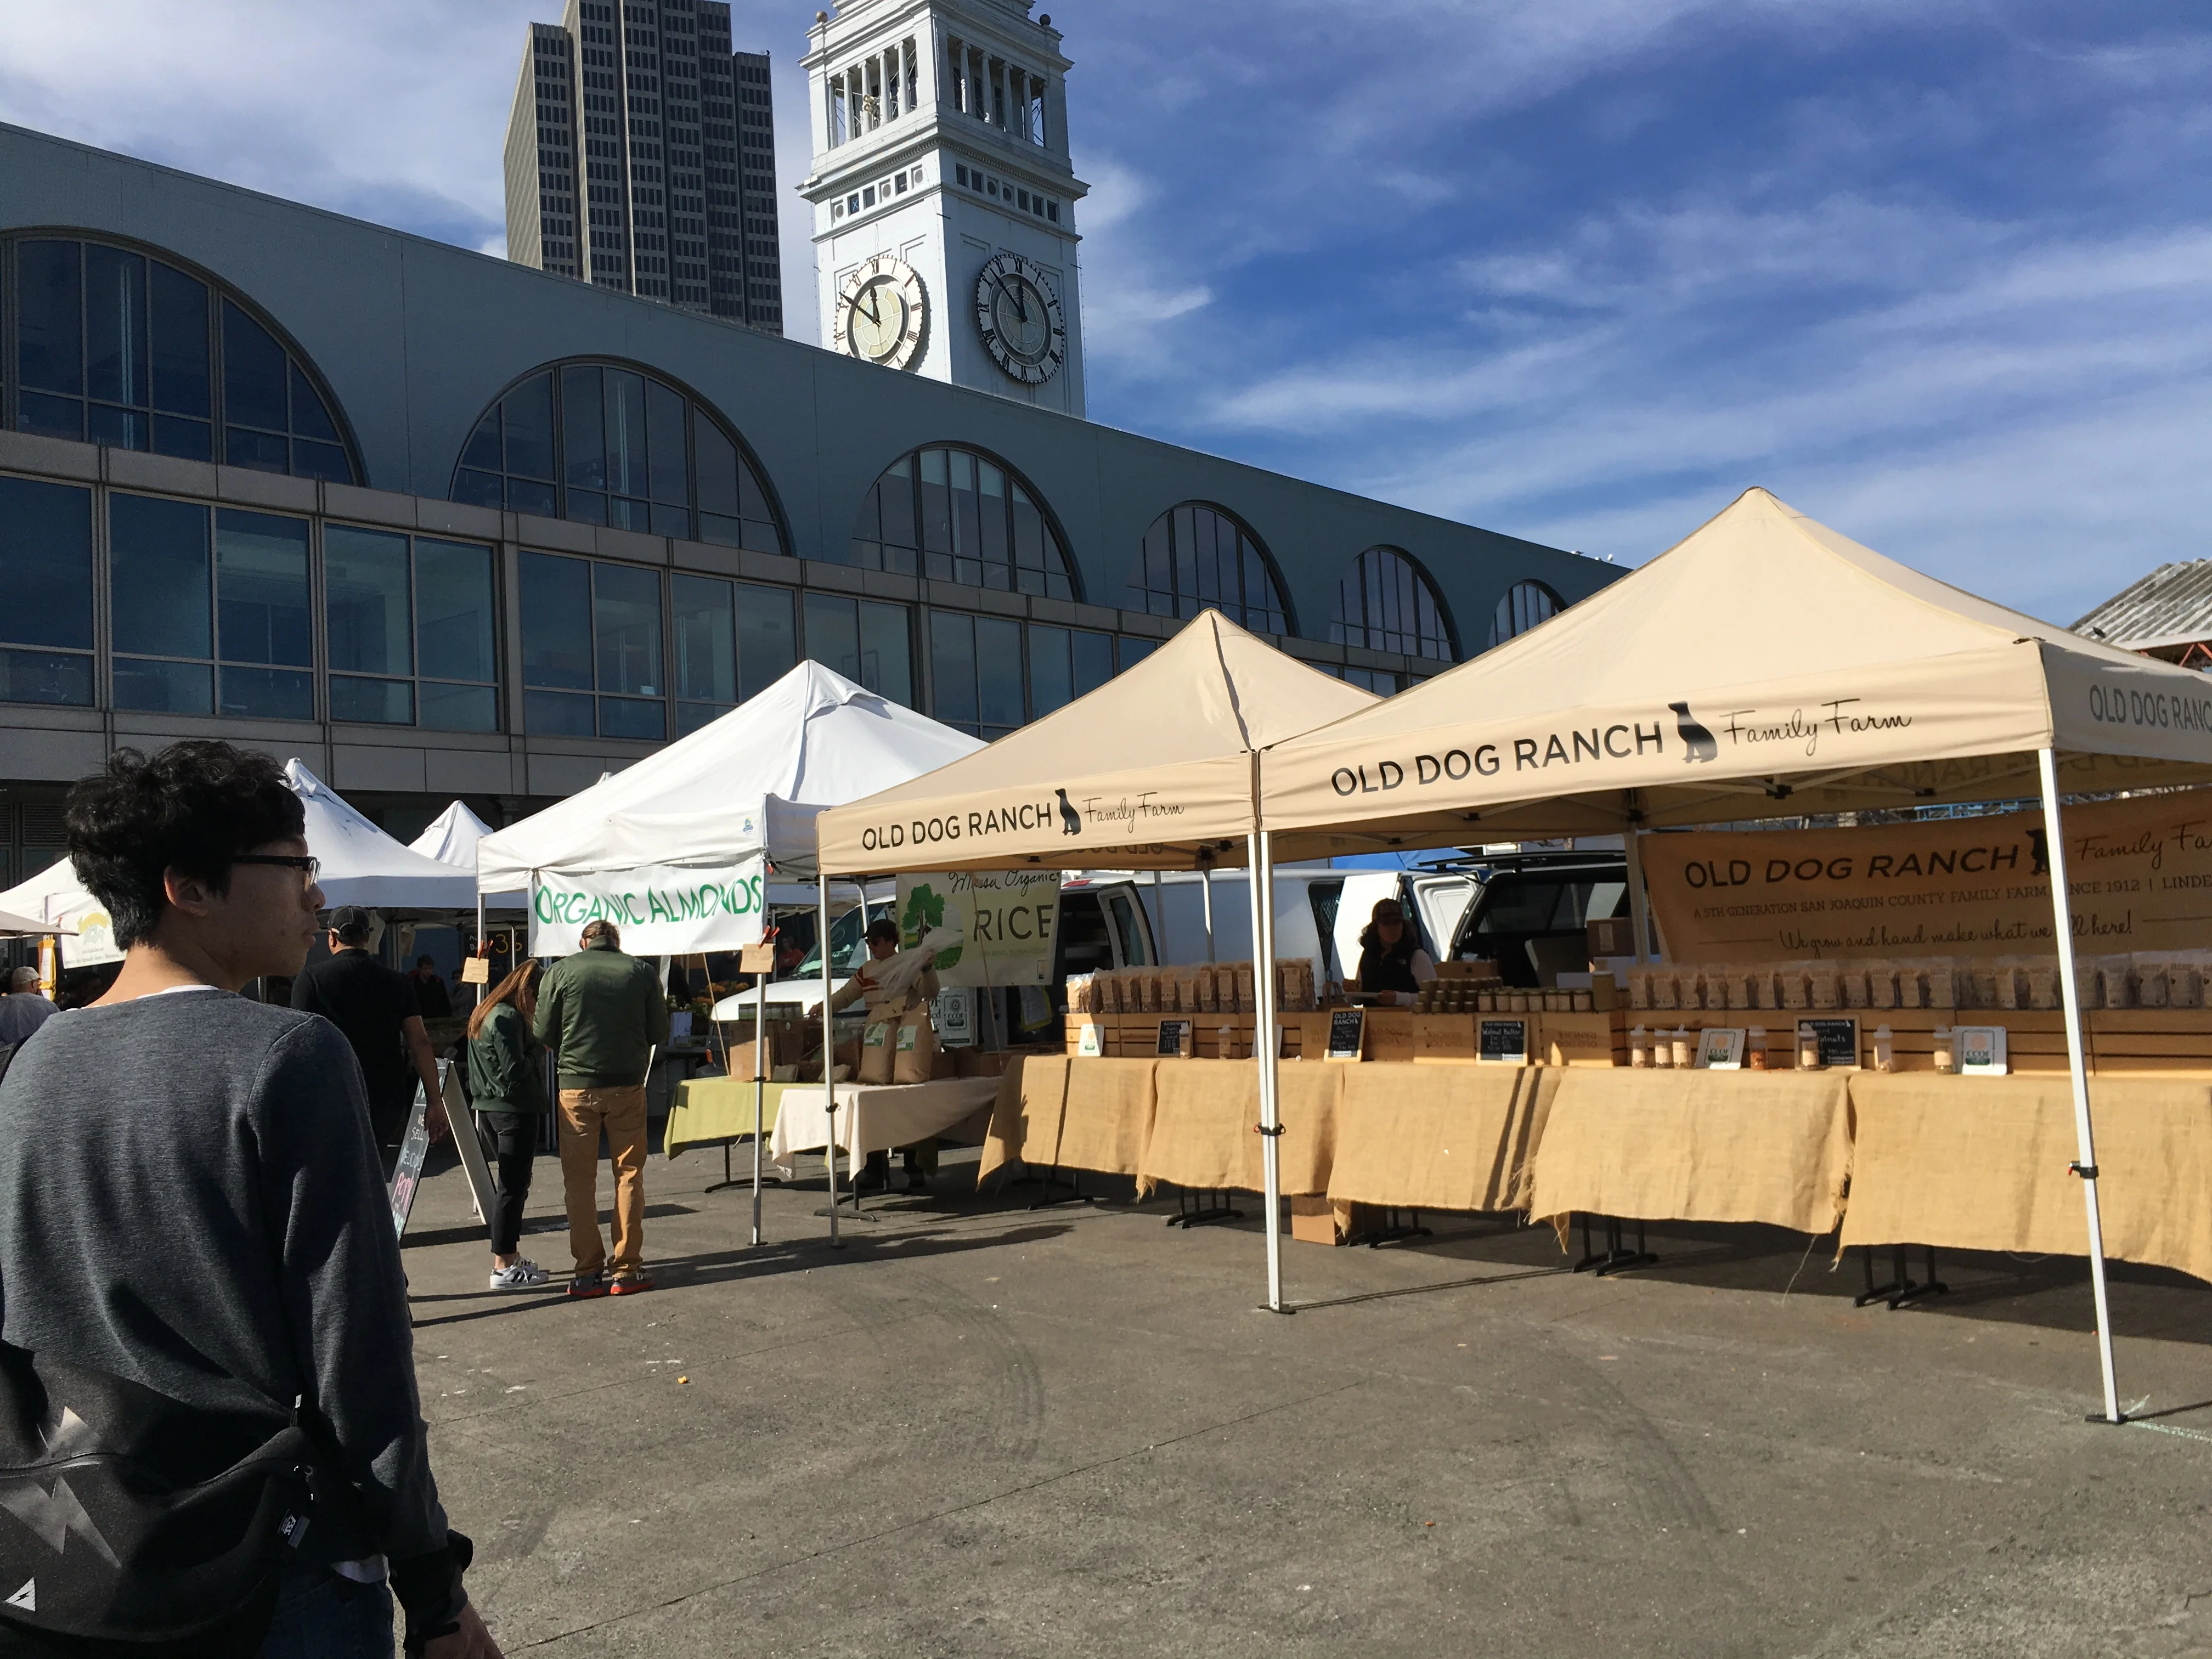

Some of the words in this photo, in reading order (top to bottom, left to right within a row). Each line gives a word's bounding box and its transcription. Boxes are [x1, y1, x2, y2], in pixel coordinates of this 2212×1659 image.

[1718, 708, 1818, 757] Family
[1821, 698, 1912, 735] Farm
[2089, 685, 2127, 724] OLD
[2130, 690, 2169, 728] DOG
[1331, 760, 1404, 797] OLD
[1415, 744, 1499, 785] DOG
[1514, 720, 1663, 771] RANCH
[862, 824, 904, 851] OLD
[912, 815, 961, 844] DOG
[968, 802, 1052, 837] RANCH
[1082, 797, 1135, 834] Family
[1137, 792, 1184, 818] Farm
[1684, 859, 1751, 889] OLD
[1765, 857, 1853, 883] DOG
[1867, 845, 2018, 878] RANCH
[2074, 831, 2163, 871] Family
[534, 885, 645, 925] ORGANIC
[647, 874, 763, 924] ALMONDS
[1694, 909, 1701, 919] A
[1703, 907, 1725, 918] 5TH
[1726, 902, 1797, 918] GENERATION
[1801, 900, 1825, 913] SAN
[1830, 896, 1884, 911] JOAQUIN
[1888, 892, 1945, 907] COUNTY
[1950, 888, 2001, 903] FAMILY
[2107, 879, 2140, 893] 1912
[973, 904, 1054, 942] RICE
[1778, 928, 1809, 951] We
[1810, 935, 1842, 960] grow
[1846, 927, 1880, 948] and
[1881, 924, 1927, 946] hand
[1931, 921, 1976, 944] make
[1976, 918, 2027, 942] what
[2030, 925, 2053, 939] we
[2091, 909, 2133, 935] here!
[410, 1126, 424, 1141] SELL
